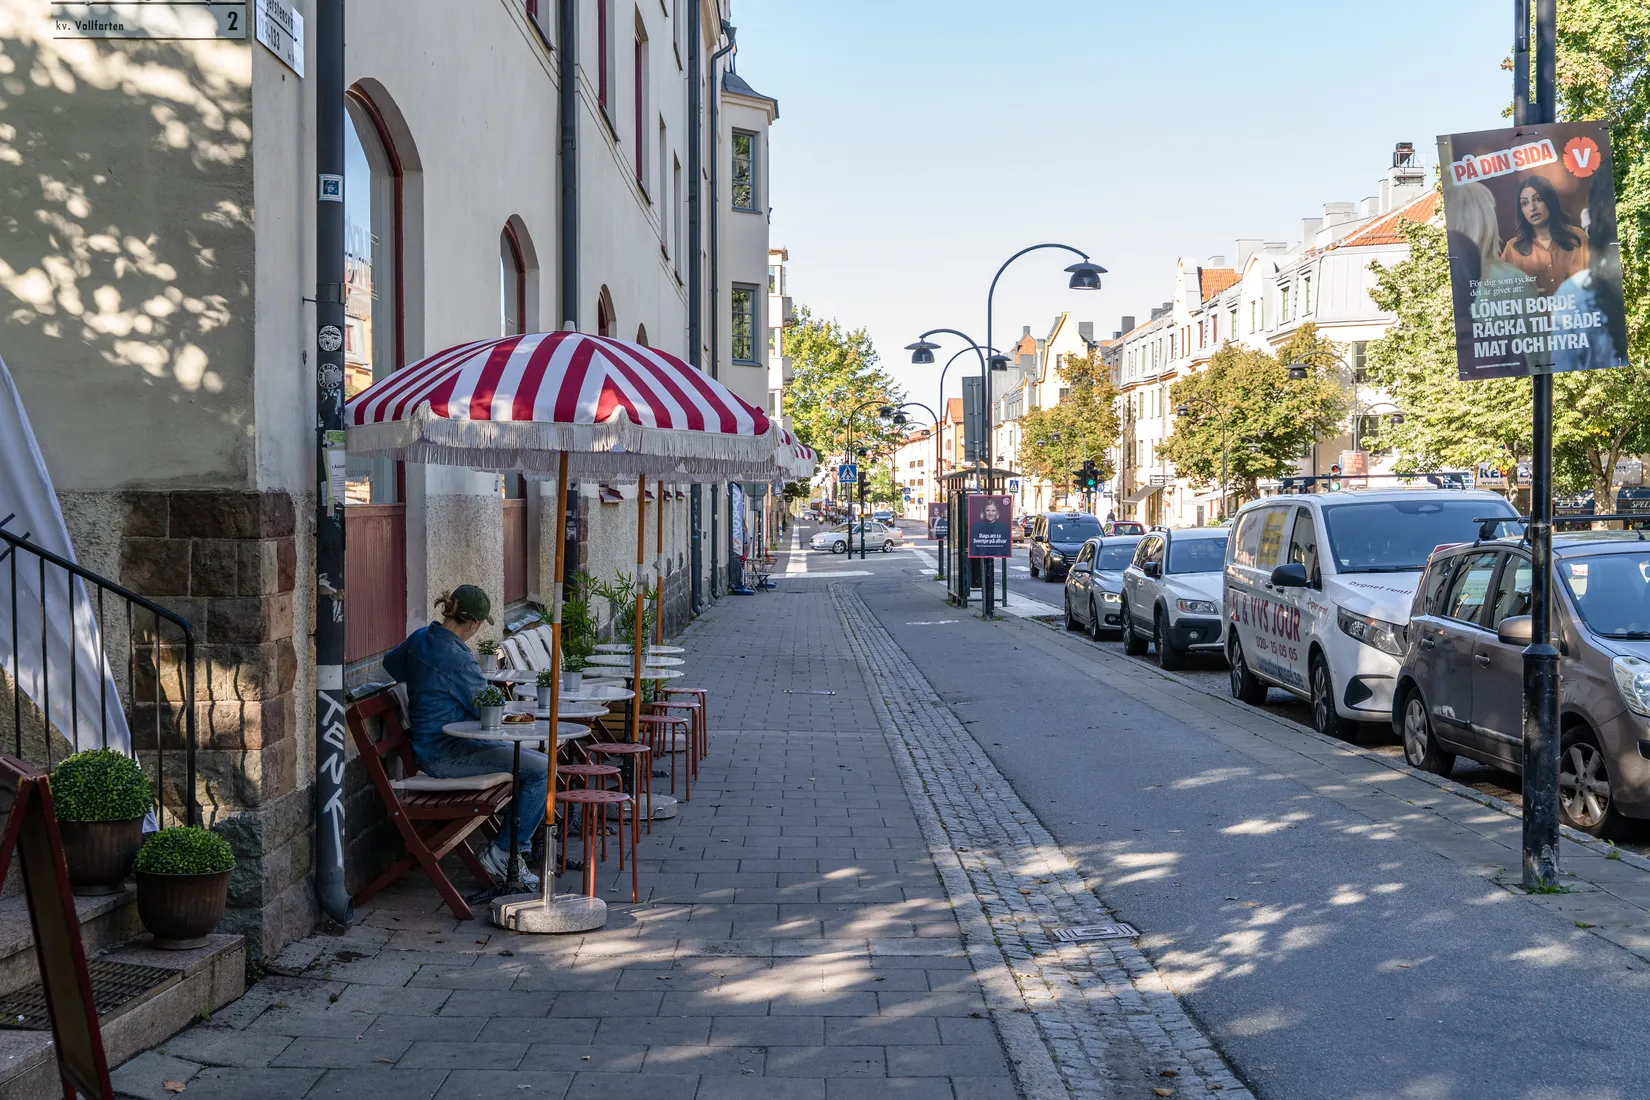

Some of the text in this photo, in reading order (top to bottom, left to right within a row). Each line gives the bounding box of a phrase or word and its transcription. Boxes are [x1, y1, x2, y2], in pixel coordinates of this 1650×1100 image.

[55, 20, 124, 31] kv. Vallfarten
[227, 11, 238, 31] 2
[1454, 143, 1553, 182] PÅ DIN SIDA
[1572, 147, 1591, 169] V
[1469, 279, 1482, 288] För
[1484, 278, 1496, 287] dig
[1514, 275, 1538, 285] tycker
[1470, 288, 1482, 296] det
[1493, 286, 1510, 296] givet
[1470, 294, 1576, 319] LÖNEN BORDE
[1472, 310, 1602, 339] RÄCKA TILL BÅDE
[1474, 332, 1590, 359] MAT OCH HYRA
[1348, 580, 1384, 590] Dygnet
[1251, 596, 1268, 632] VVS
[1272, 602, 1301, 642] JOUR
[1270, 640, 1277, 654] 15
[1279, 644, 1287, 658] 05
[1289, 647, 1297, 661] 05
